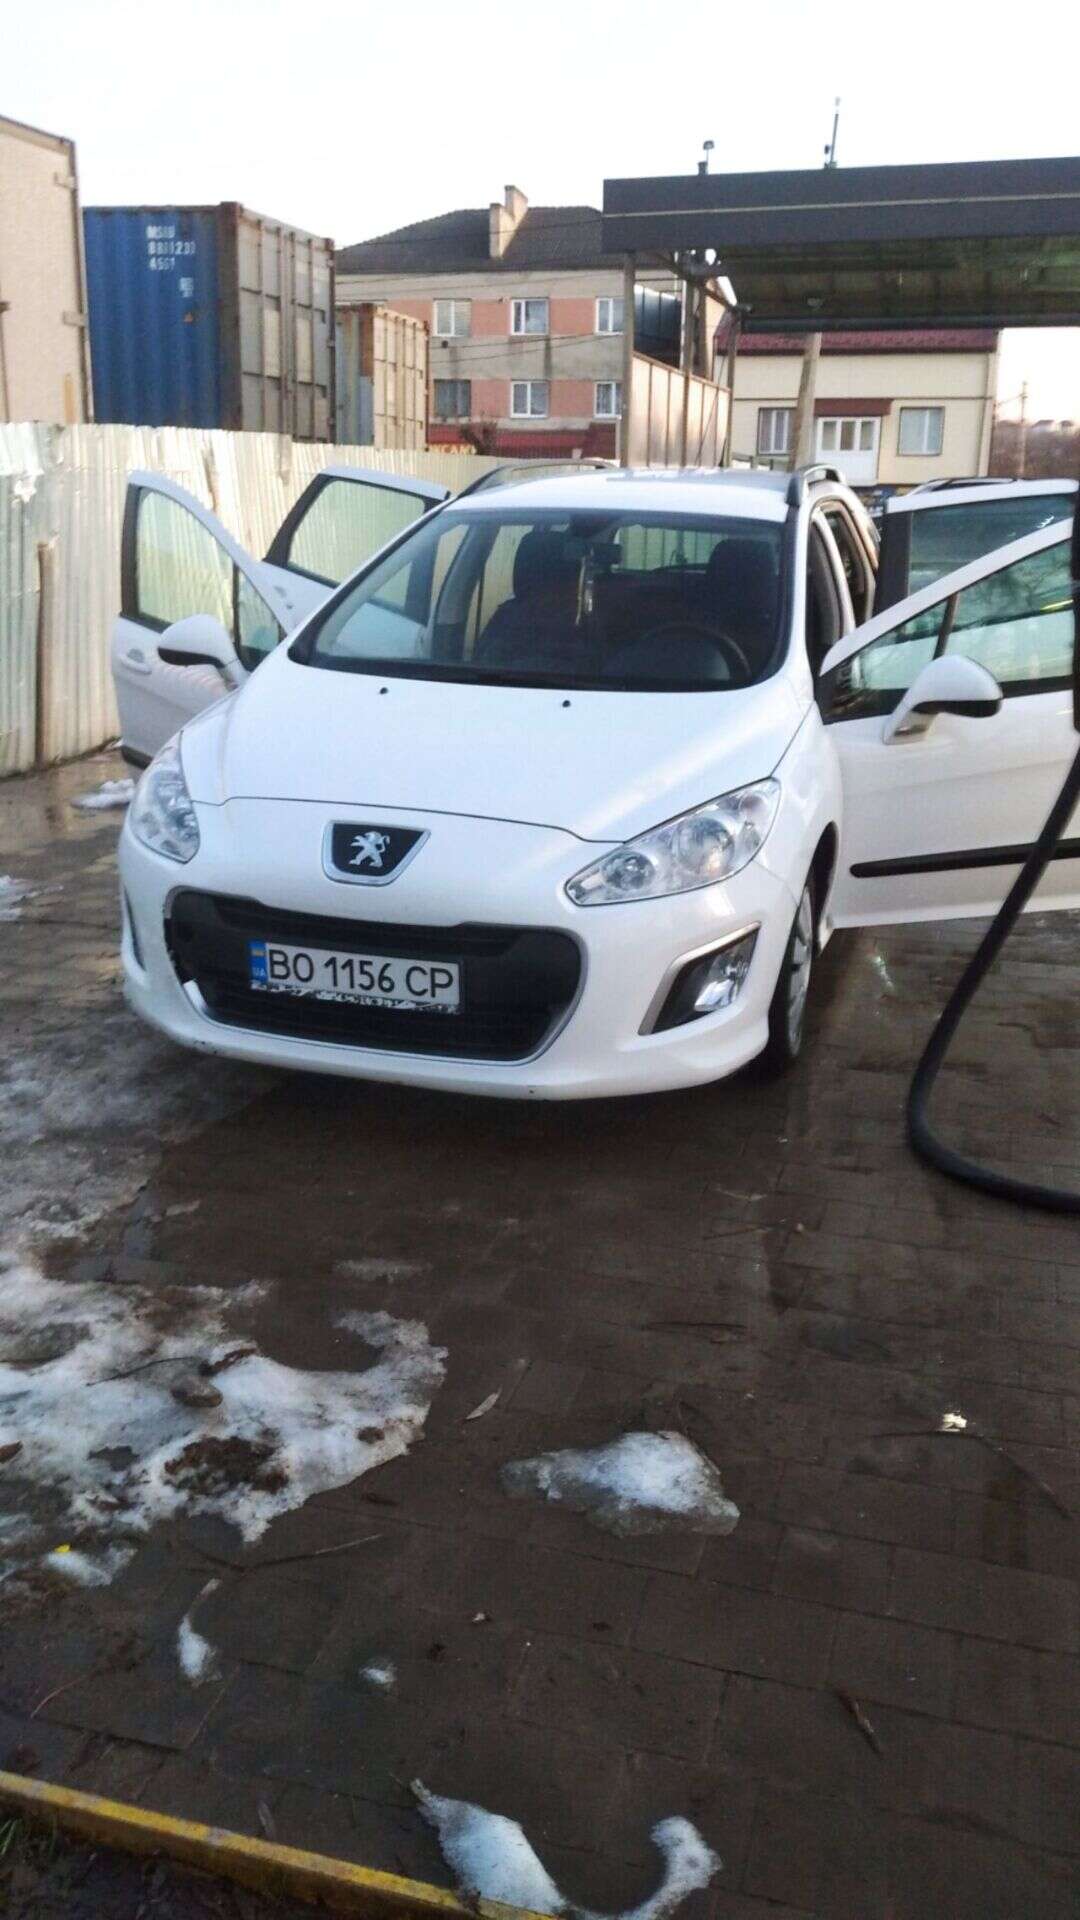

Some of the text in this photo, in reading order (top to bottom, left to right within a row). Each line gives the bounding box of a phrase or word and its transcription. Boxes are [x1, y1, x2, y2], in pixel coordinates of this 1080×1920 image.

[268, 949, 454, 998] BO 1156 CP
